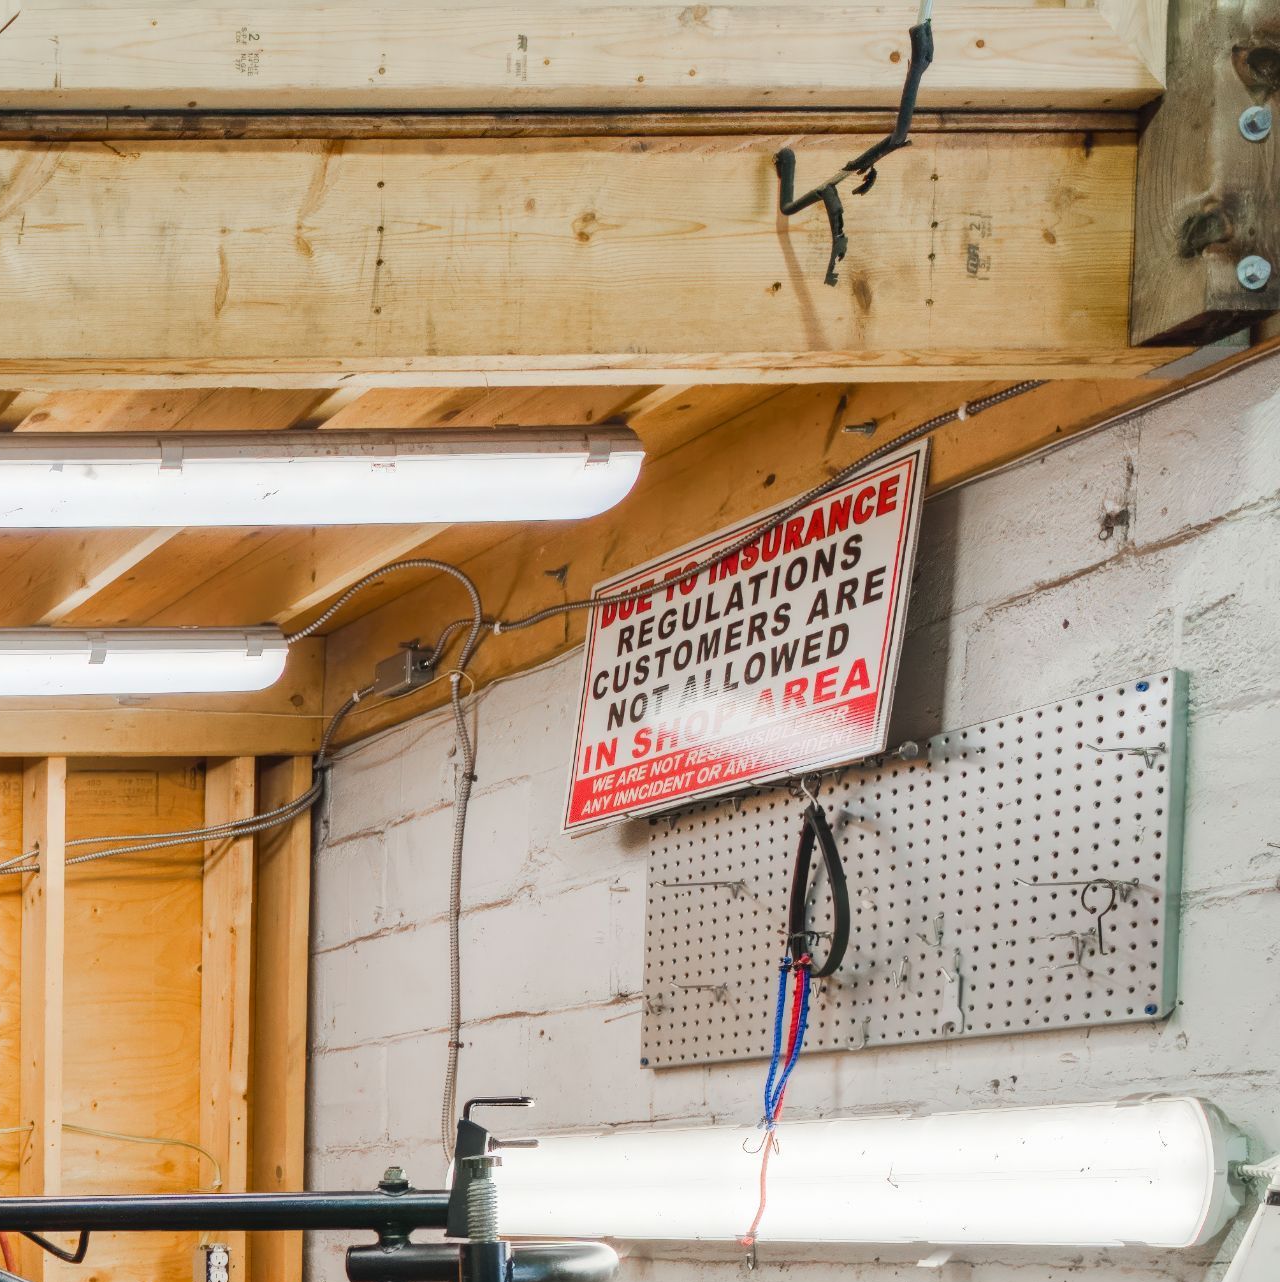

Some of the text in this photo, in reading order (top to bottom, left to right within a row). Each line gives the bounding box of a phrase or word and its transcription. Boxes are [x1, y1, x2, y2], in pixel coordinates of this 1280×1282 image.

[616, 533, 864, 657] REGULATIONS
[665, 561, 700, 602] TO
[708, 475, 901, 586] INSURANCE
[593, 566, 887, 700] CUSTOMERS ARE
[607, 622, 850, 731] NOT ALLOWED
[583, 658, 871, 774] IN SHOP AREA
[581, 794, 611, 817] ANY
[612, 771, 696, 808] INNCIDENT
[697, 762, 721, 784] OR
[724, 749, 762, 779] ANY
[592, 774, 617, 795] WE
[616, 763, 648, 787] ARE
[650, 754, 684, 779] NOT
